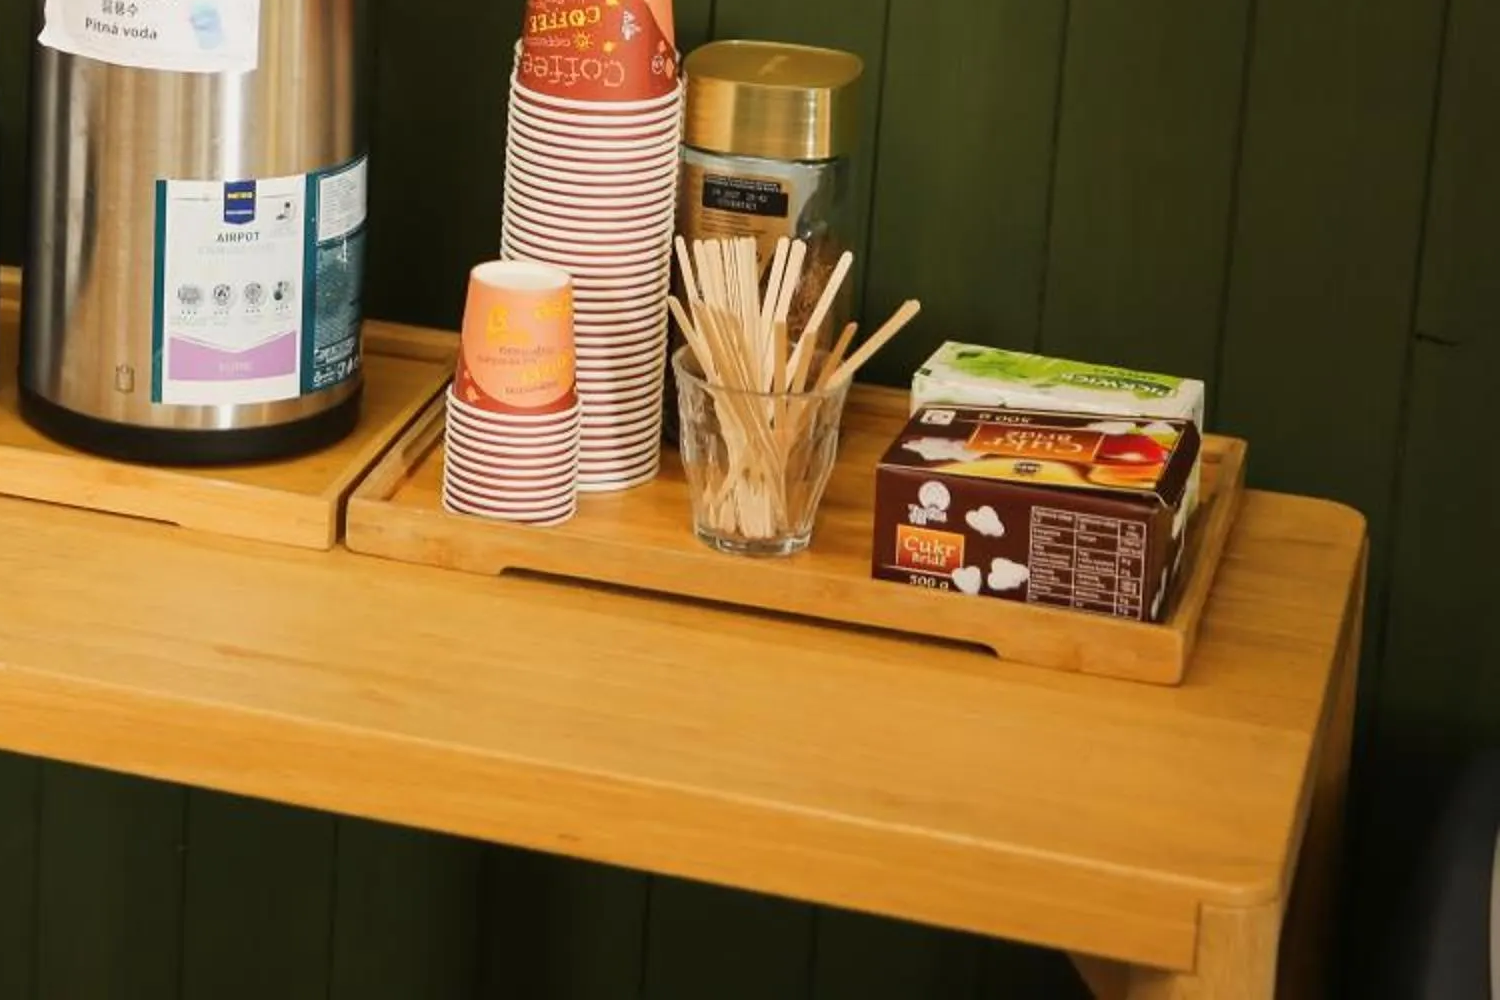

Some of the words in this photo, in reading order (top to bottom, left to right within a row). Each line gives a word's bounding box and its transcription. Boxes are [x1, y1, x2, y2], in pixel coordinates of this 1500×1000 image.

[84, 17, 119, 36] Pitná
[123, 25, 158, 41] voda
[530, 6, 600, 33] COFFEE
[216, 231, 261, 244] AIRPOT
[904, 535, 957, 557] Cukr
